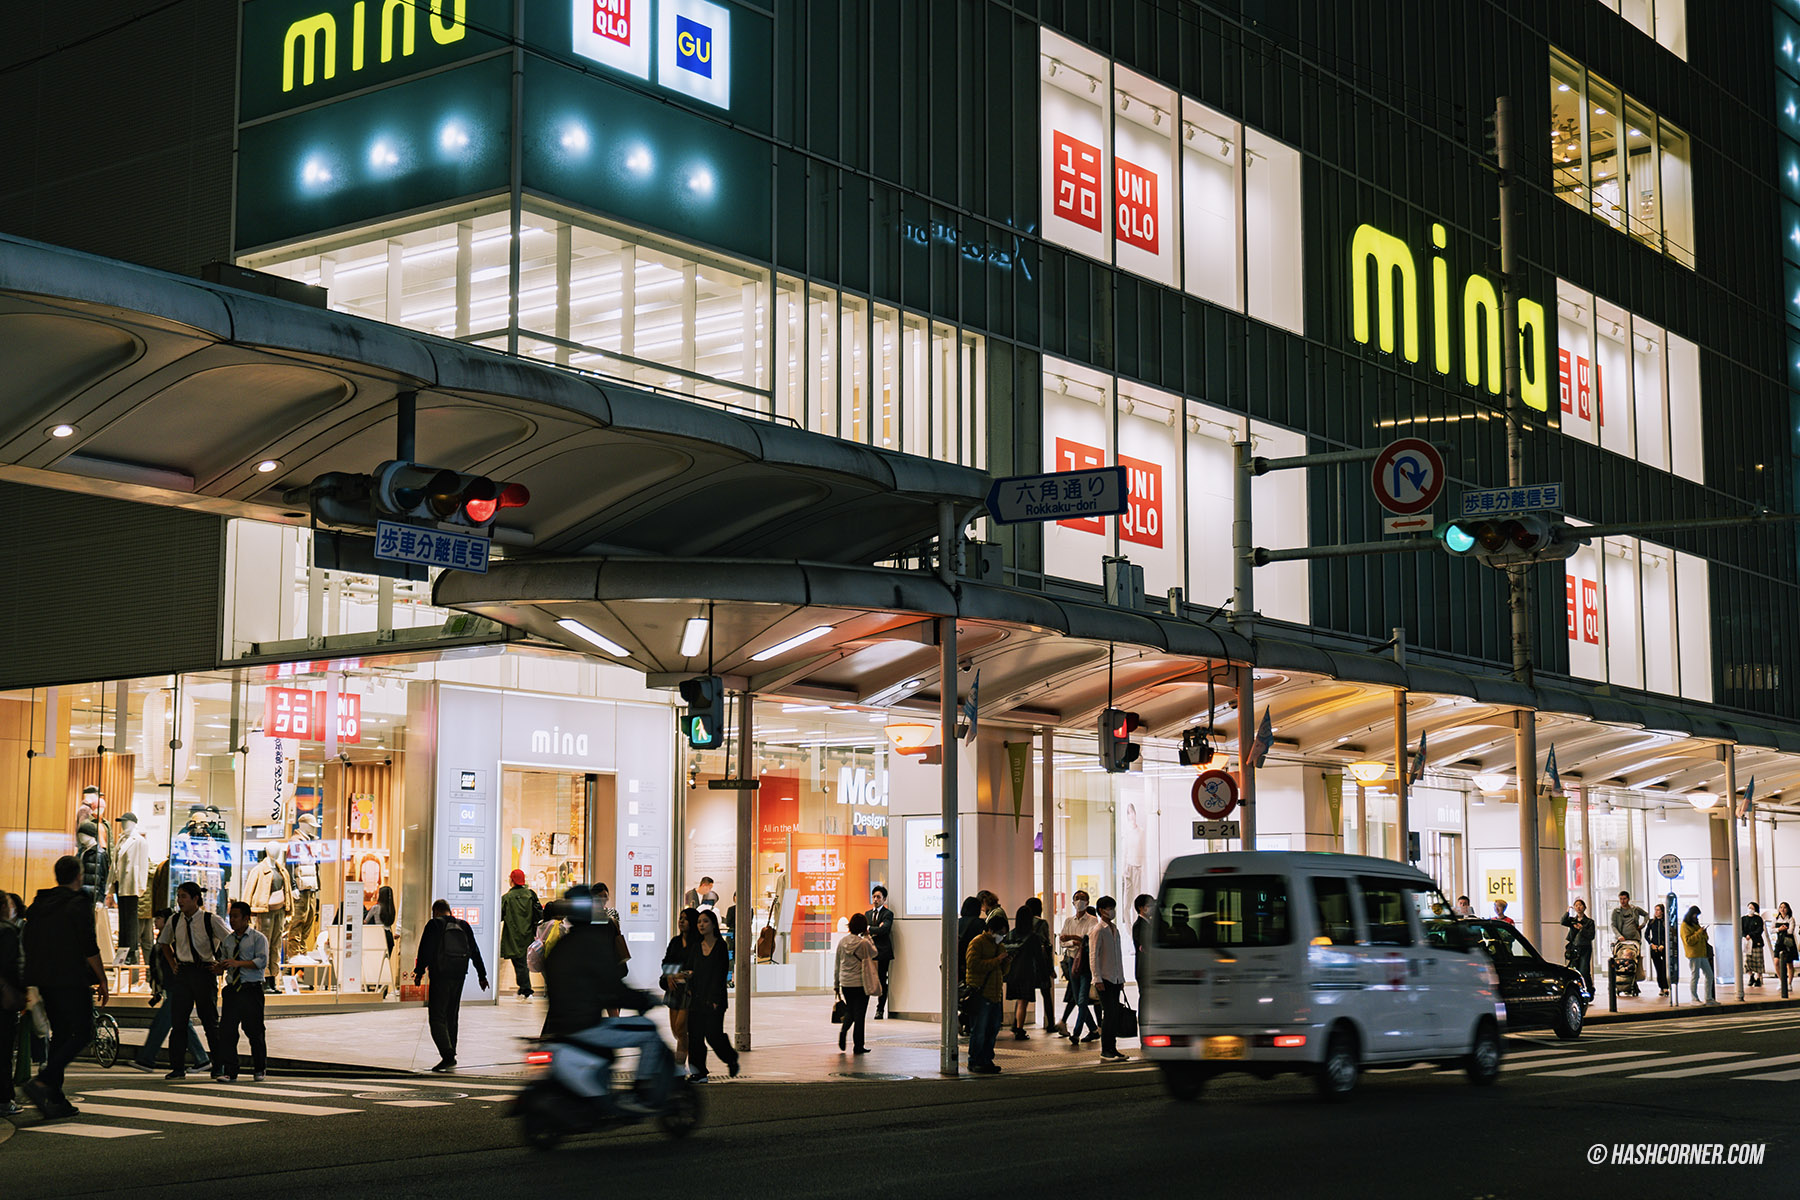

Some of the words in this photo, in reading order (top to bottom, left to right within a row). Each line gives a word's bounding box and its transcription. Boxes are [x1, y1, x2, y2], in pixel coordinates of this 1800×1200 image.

[596, 10, 628, 39] QLO
[283, 0, 466, 93] mina
[678, 31, 710, 63] GU
[1118, 168, 1151, 208] UNI
[1118, 203, 1154, 241] QLO
[1352, 222, 1548, 412] mina
[1015, 476, 1105, 504] 六角通り
[1465, 487, 1558, 513] 歩車分離信号
[1026, 499, 1097, 515] Rokkaku-dori
[380, 528, 485, 568] 歩車分離信号
[531, 726, 588, 756] mina
[461, 809, 475, 820] GU
[853, 811, 886, 830] Design
[1437, 805, 1460, 823] mina
